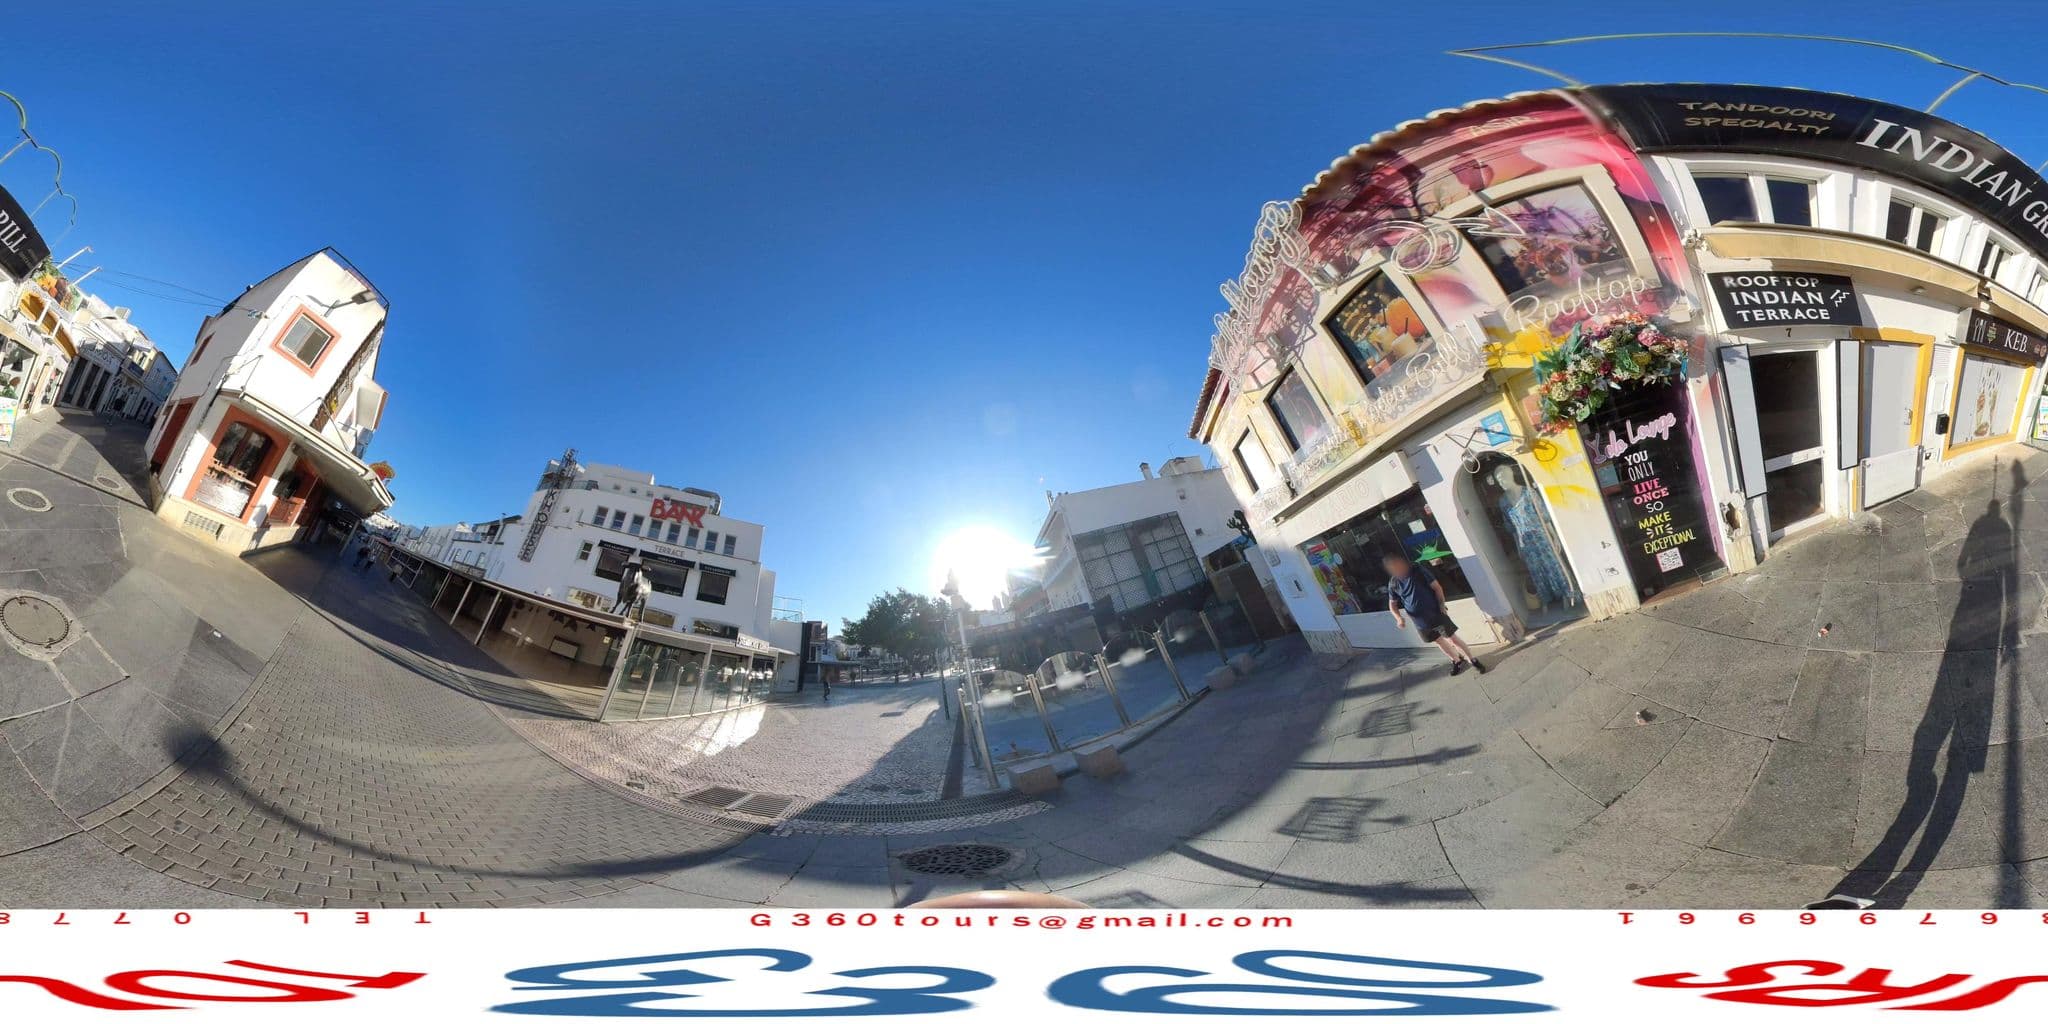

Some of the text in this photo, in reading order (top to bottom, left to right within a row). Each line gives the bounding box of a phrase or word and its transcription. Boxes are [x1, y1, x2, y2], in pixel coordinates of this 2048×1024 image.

[1678, 102, 1836, 121] TANDOORI
[1683, 117, 1830, 135] SPECIALTY
[1856, 118, 2032, 208] INDIAN
[1722, 276, 1819, 288] ROOFTOP
[1503, 274, 1645, 331] Rooftop
[1729, 290, 1824, 305] INDIAN
[1736, 308, 1830, 322] TERRACE
[1785, 327, 1792, 338] 7
[2004, 328, 2027, 353] KEB.
[1626, 412, 1676, 444] Lounge
[1624, 450, 1648, 466] YOU
[1628, 461, 1655, 481] ONLY
[1633, 478, 1662, 495] LIVE
[1633, 487, 1669, 505] ONCE
[650, 498, 707, 528] BANK
[1645, 501, 1664, 513] SO
[1638, 511, 1672, 530] MAKE
[1655, 525, 1665, 536] IT
[1643, 528, 1696, 554] EXCEPTIONAL
[654, 545, 686, 557] TERRACE
